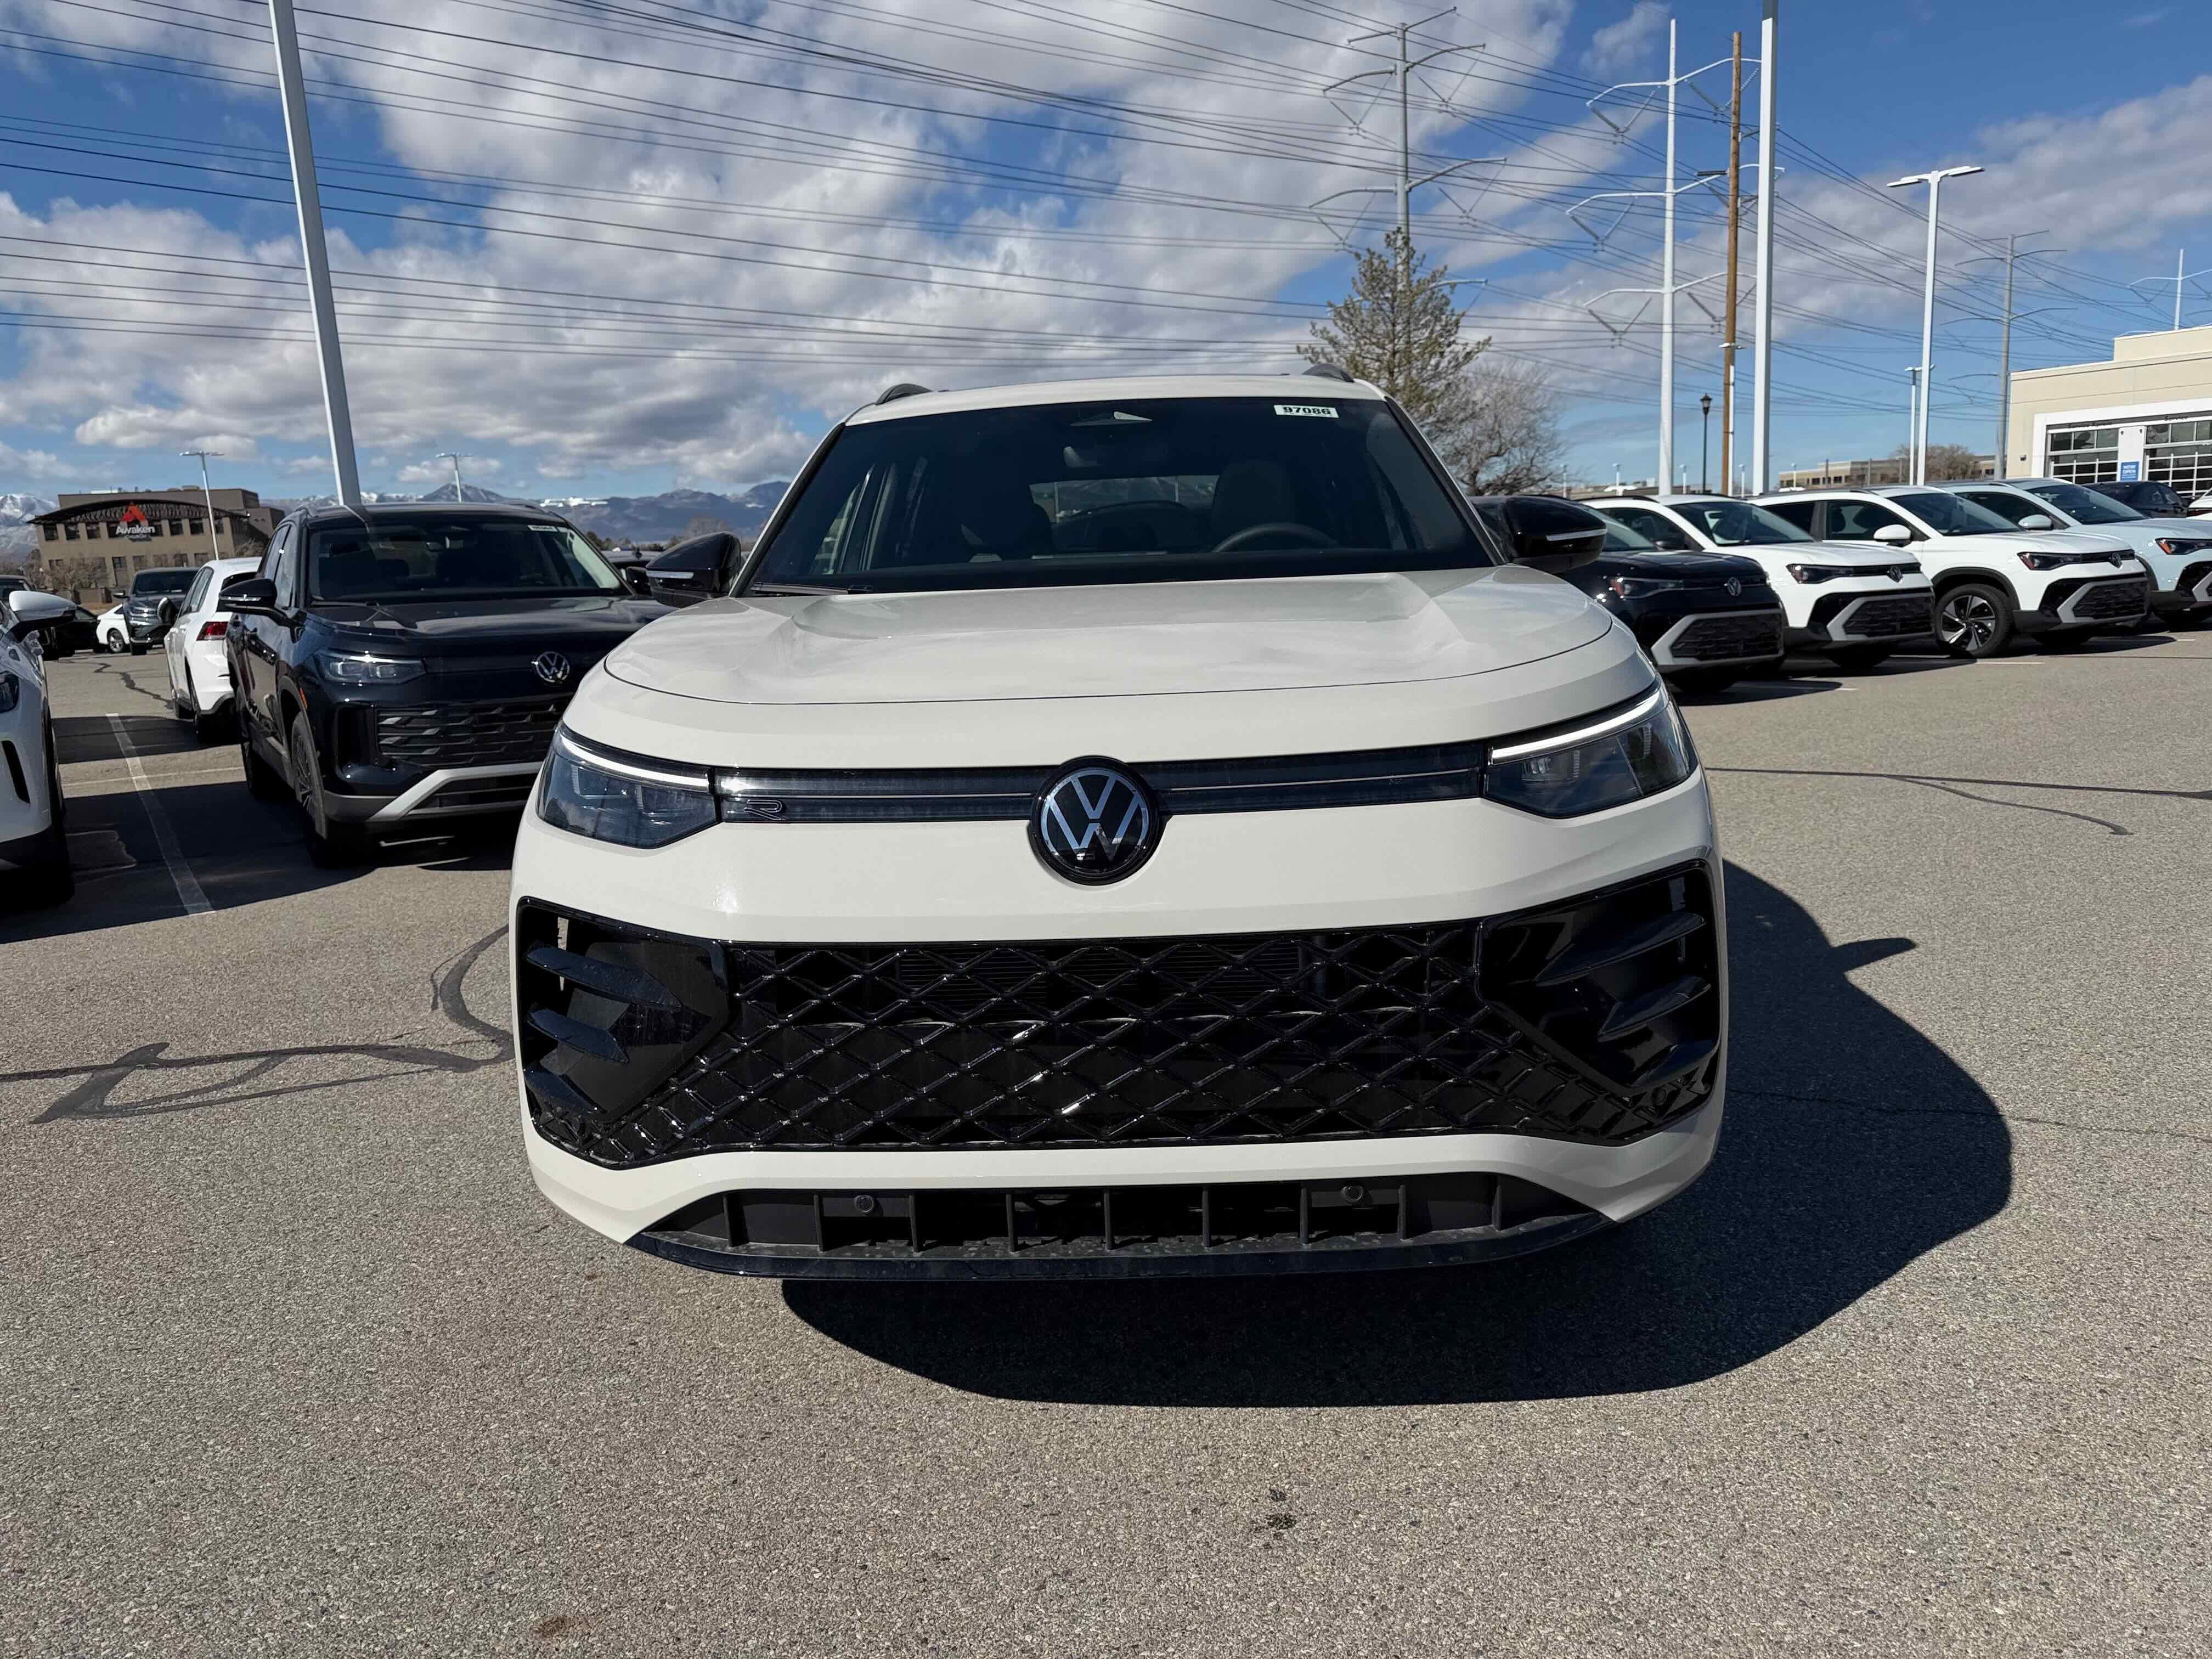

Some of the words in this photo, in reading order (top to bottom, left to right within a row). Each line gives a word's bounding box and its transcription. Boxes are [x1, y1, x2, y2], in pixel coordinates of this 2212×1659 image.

[1283, 407, 1331, 415] 97086
[116, 524, 155, 535] Awaken
[536, 651, 570, 682] VW
[743, 799, 786, 821] R
[1041, 768, 1149, 873] VW
